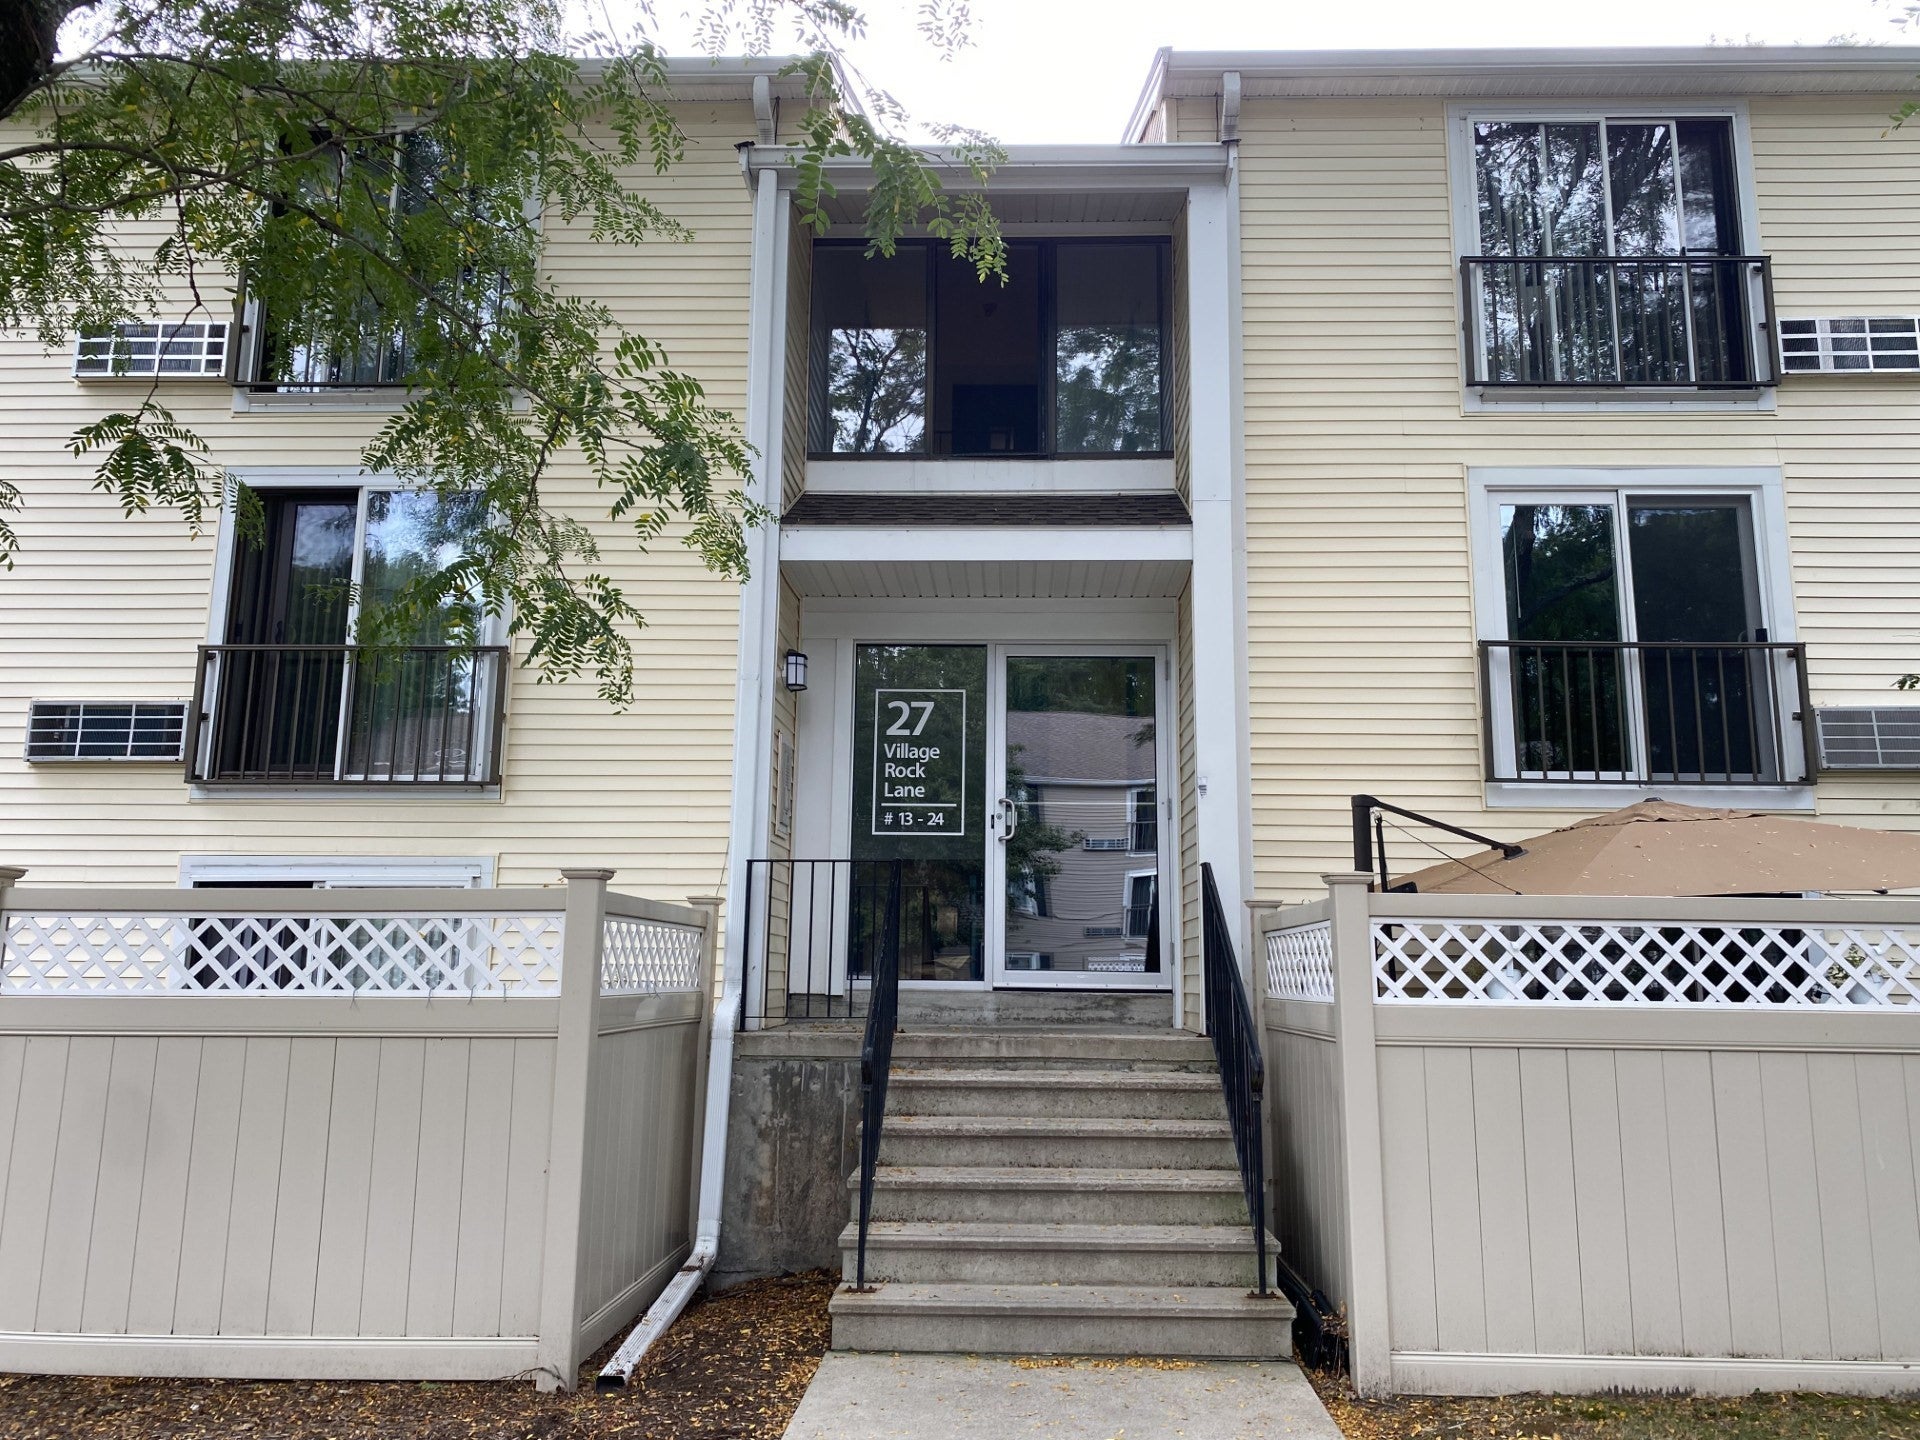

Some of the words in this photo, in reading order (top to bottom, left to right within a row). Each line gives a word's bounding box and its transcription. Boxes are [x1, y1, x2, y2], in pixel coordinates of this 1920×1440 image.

[886, 700, 935, 736] 27
[884, 743, 940, 763] Village
[884, 762, 926, 778] Rock
[884, 782, 925, 798] Lane
[884, 812, 893, 826] #
[898, 812, 913, 826] 13
[927, 812, 944, 826] 24
